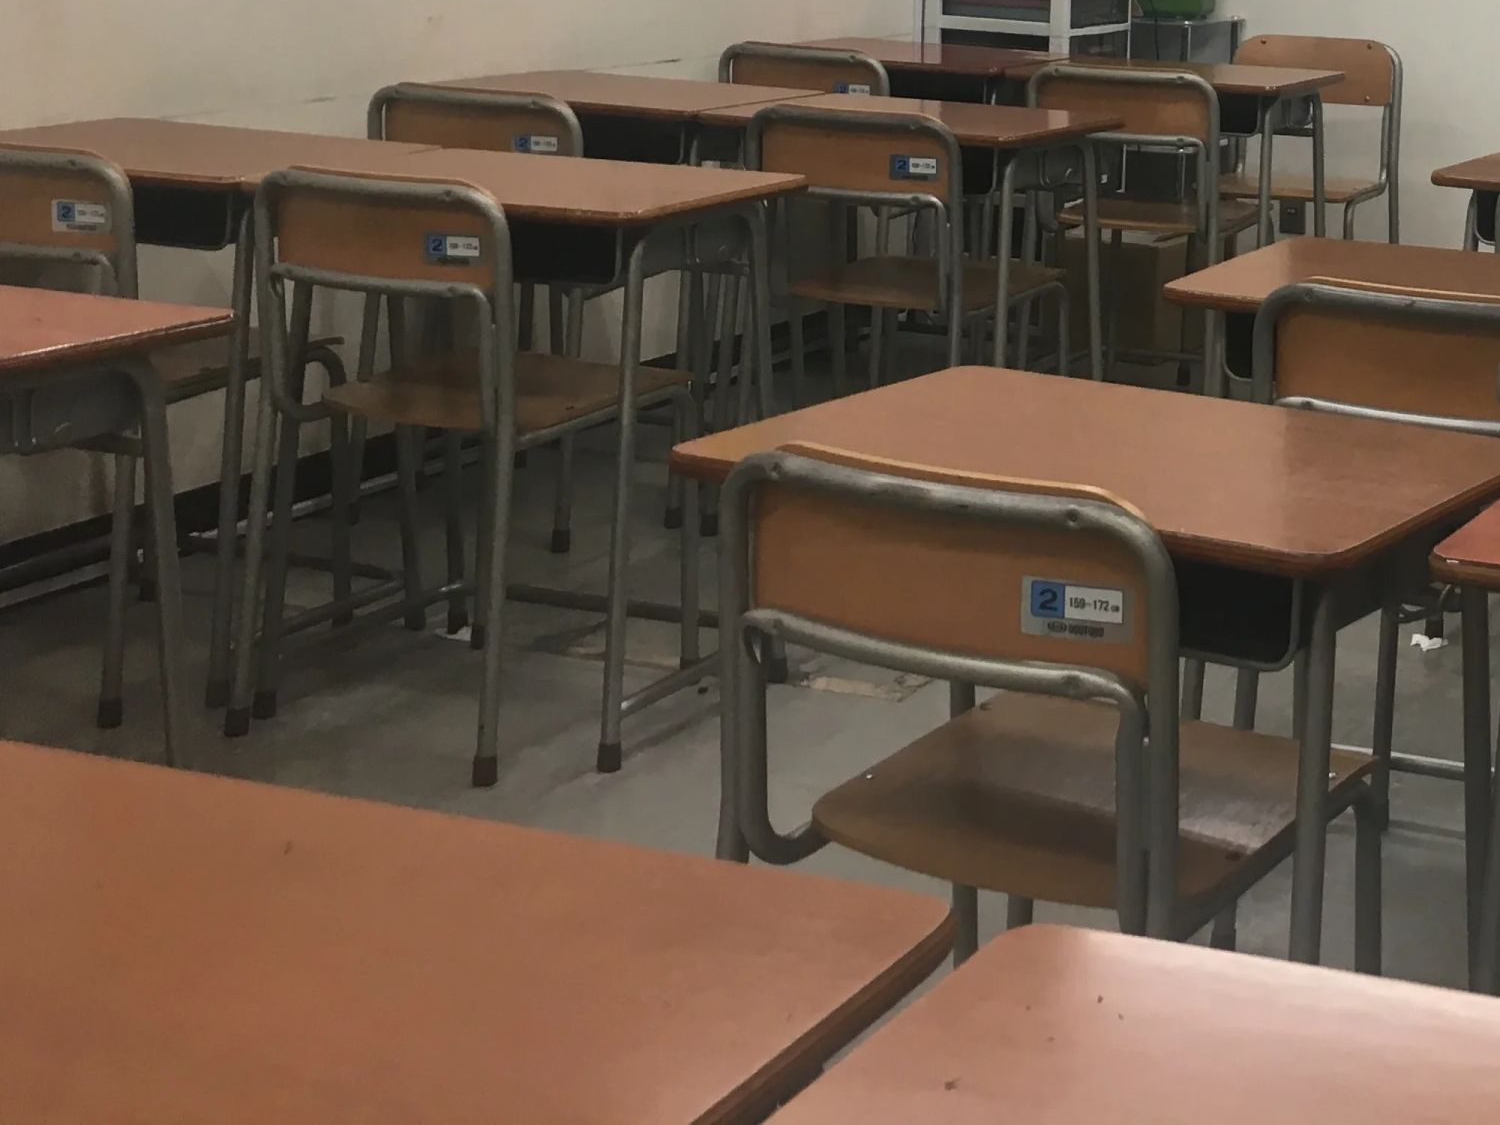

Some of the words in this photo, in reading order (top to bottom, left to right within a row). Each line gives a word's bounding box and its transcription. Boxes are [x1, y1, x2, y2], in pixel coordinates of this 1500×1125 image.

[896, 159, 907, 170] 2
[62, 205, 72, 219] 2
[431, 238, 443, 252] 2
[1038, 588, 1059, 612] 2
